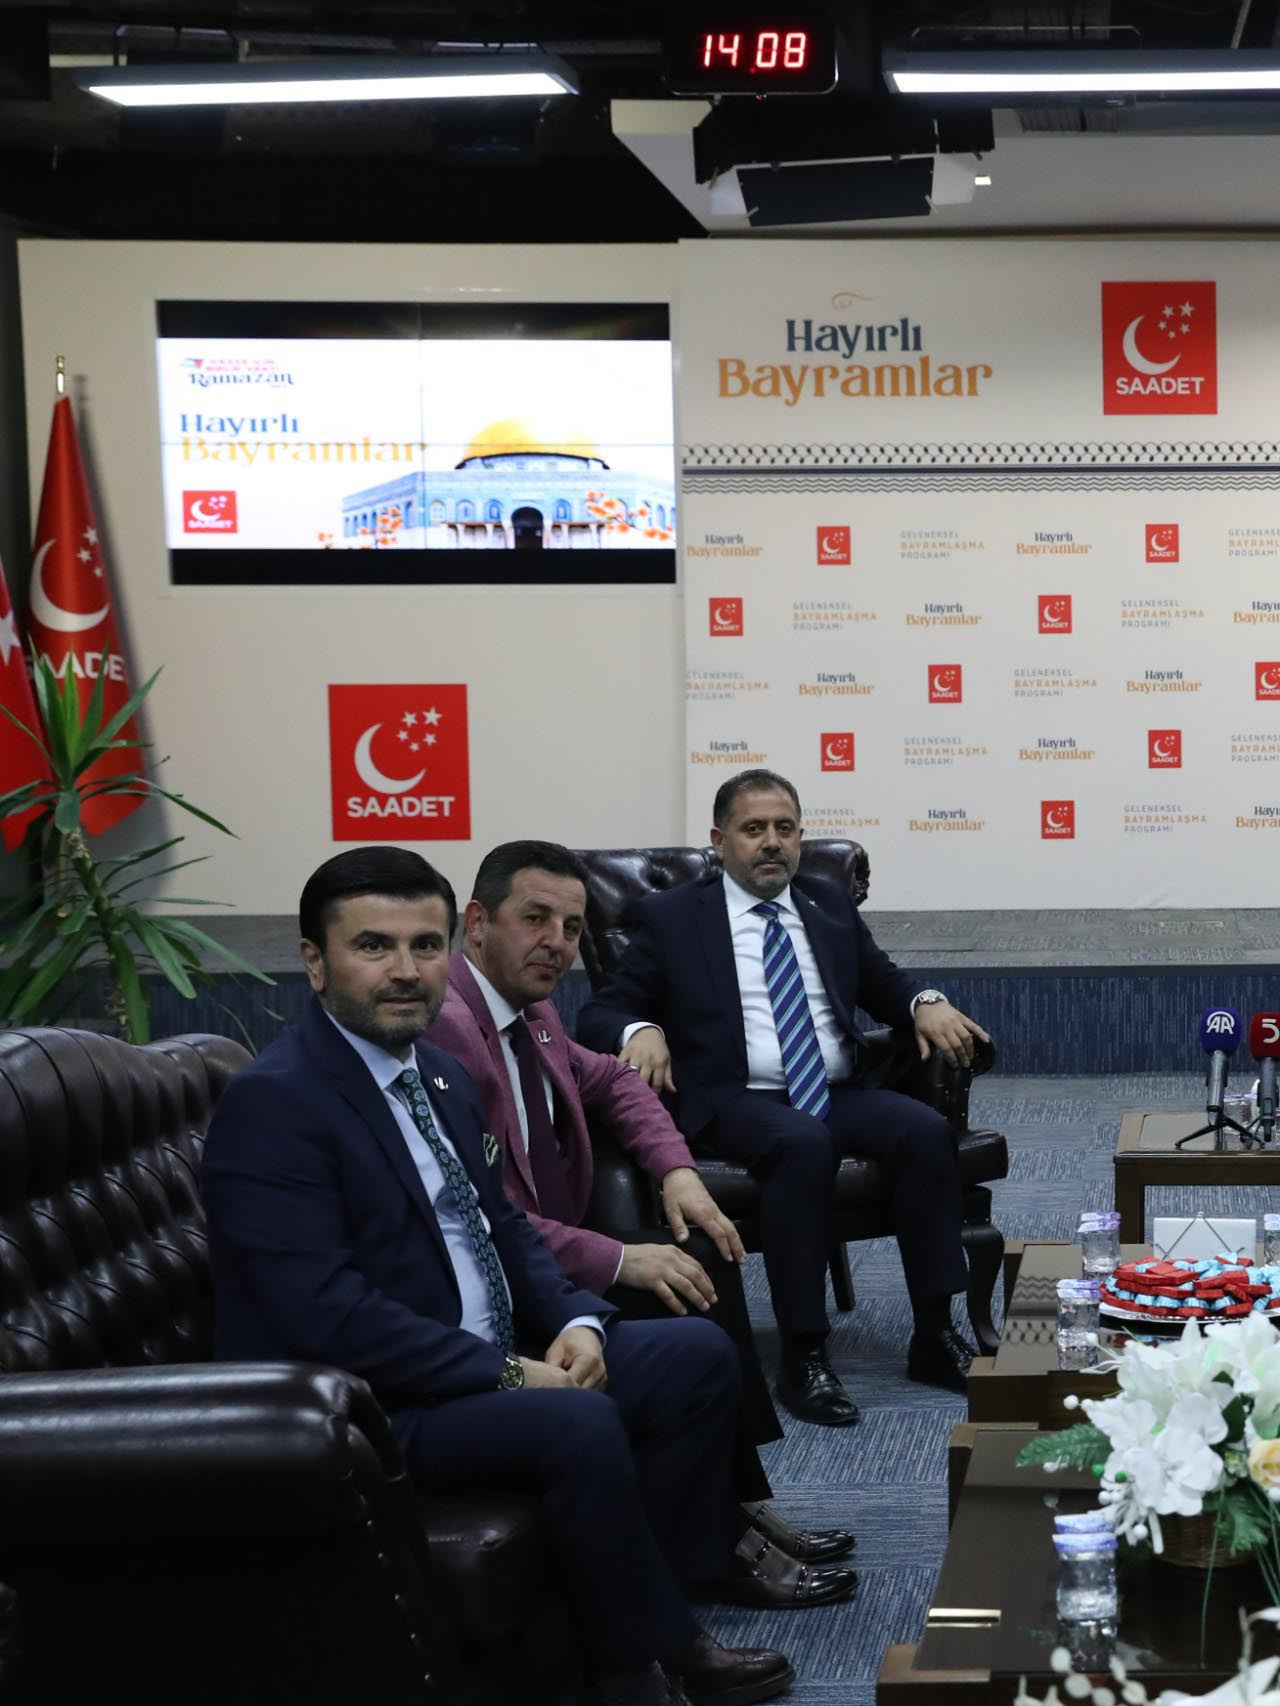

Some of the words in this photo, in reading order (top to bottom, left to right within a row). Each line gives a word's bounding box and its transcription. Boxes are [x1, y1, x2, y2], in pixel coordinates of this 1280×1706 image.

[785, 316, 922, 359] Hayırlı
[718, 355, 993, 407] Bayramlar
[1115, 376, 1204, 396] SAADET
[180, 414, 299, 438] Hayırlı
[181, 436, 428, 467] Bayramlar
[687, 545, 763, 559] Bayramlar
[1016, 543, 1093, 557] Bayramlar
[906, 613, 982, 628] Bayramlar
[799, 683, 875, 698] Bayramlar
[1126, 681, 1203, 695] Bayramlar
[691, 752, 767, 766] Bayramlar
[1019, 749, 1095, 763] Bayramlar
[347, 796, 455, 817] SAADET
[909, 820, 985, 834] Bayramlar
